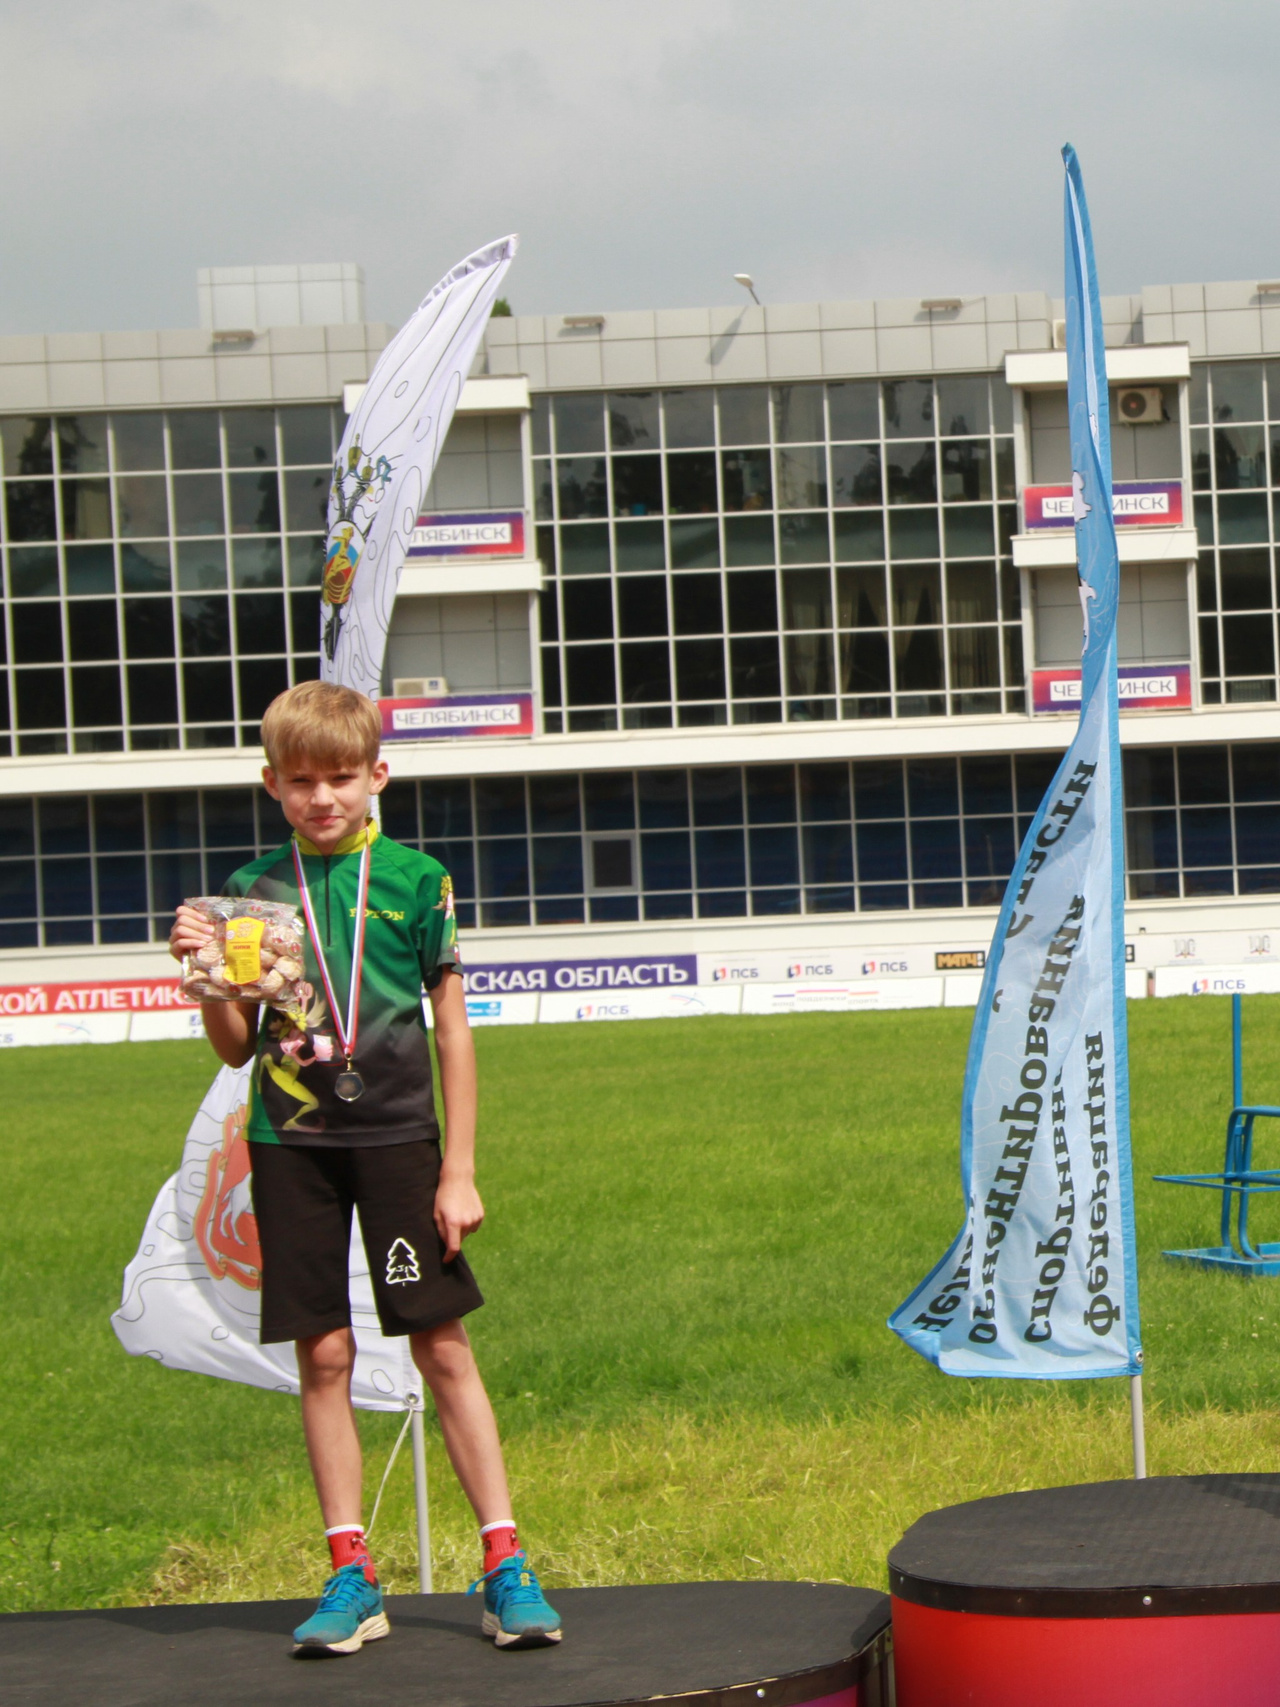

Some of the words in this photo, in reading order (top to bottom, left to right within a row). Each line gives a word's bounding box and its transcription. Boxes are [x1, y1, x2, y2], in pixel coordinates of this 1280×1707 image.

[1045, 497, 1164, 513] ЧЕИНСК
[411, 526, 506, 543] ЛЯБИНСК
[1053, 680, 1172, 697] ЧЕИНСК
[396, 707, 515, 725] ЧЕЛЯБИНСК
[730, 968, 759, 979] ПСБ
[805, 965, 833, 976] ПСБ
[880, 961, 908, 972] ПСБ
[463, 968, 547, 993] СКАЯ
[554, 963, 688, 988] ОБЛАСТЬ
[1213, 979, 1246, 991] ПСБ
[0, 987, 48, 1014] ОЙ
[54, 986, 187, 1011] АТЛЕТИК
[597, 1005, 629, 1016] ПСБ
